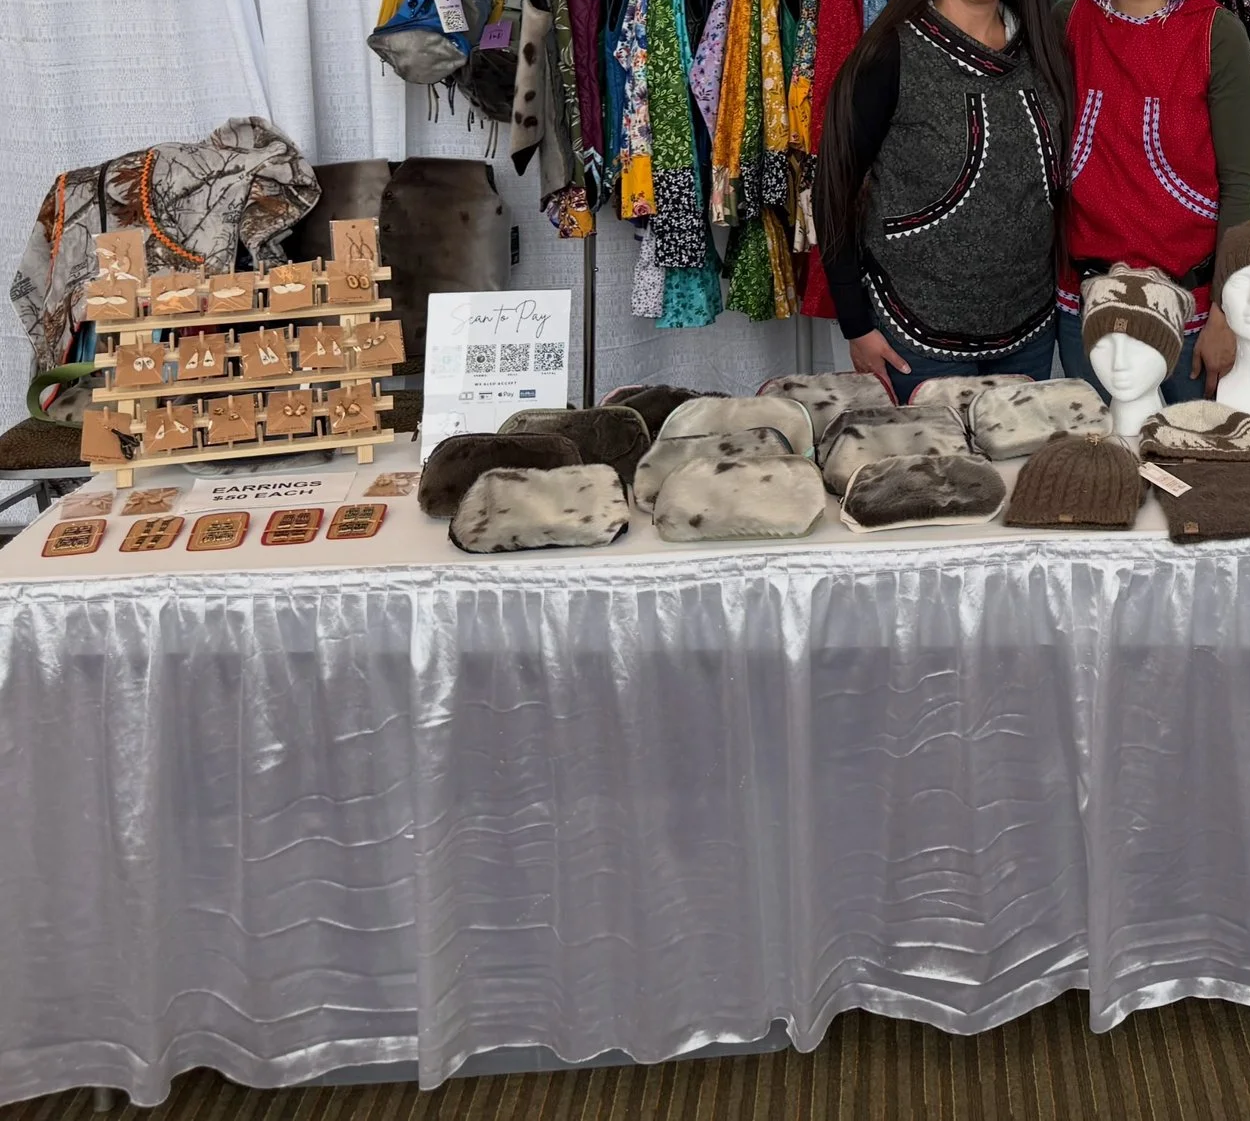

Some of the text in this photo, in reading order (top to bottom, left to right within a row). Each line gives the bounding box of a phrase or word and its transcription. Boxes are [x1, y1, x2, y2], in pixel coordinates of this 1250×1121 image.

[451, 303, 493, 336] Scan
[515, 299, 552, 338] Pay
[212, 480, 322, 494] EARRINGS
[212, 489, 313, 502] $50 EACH
